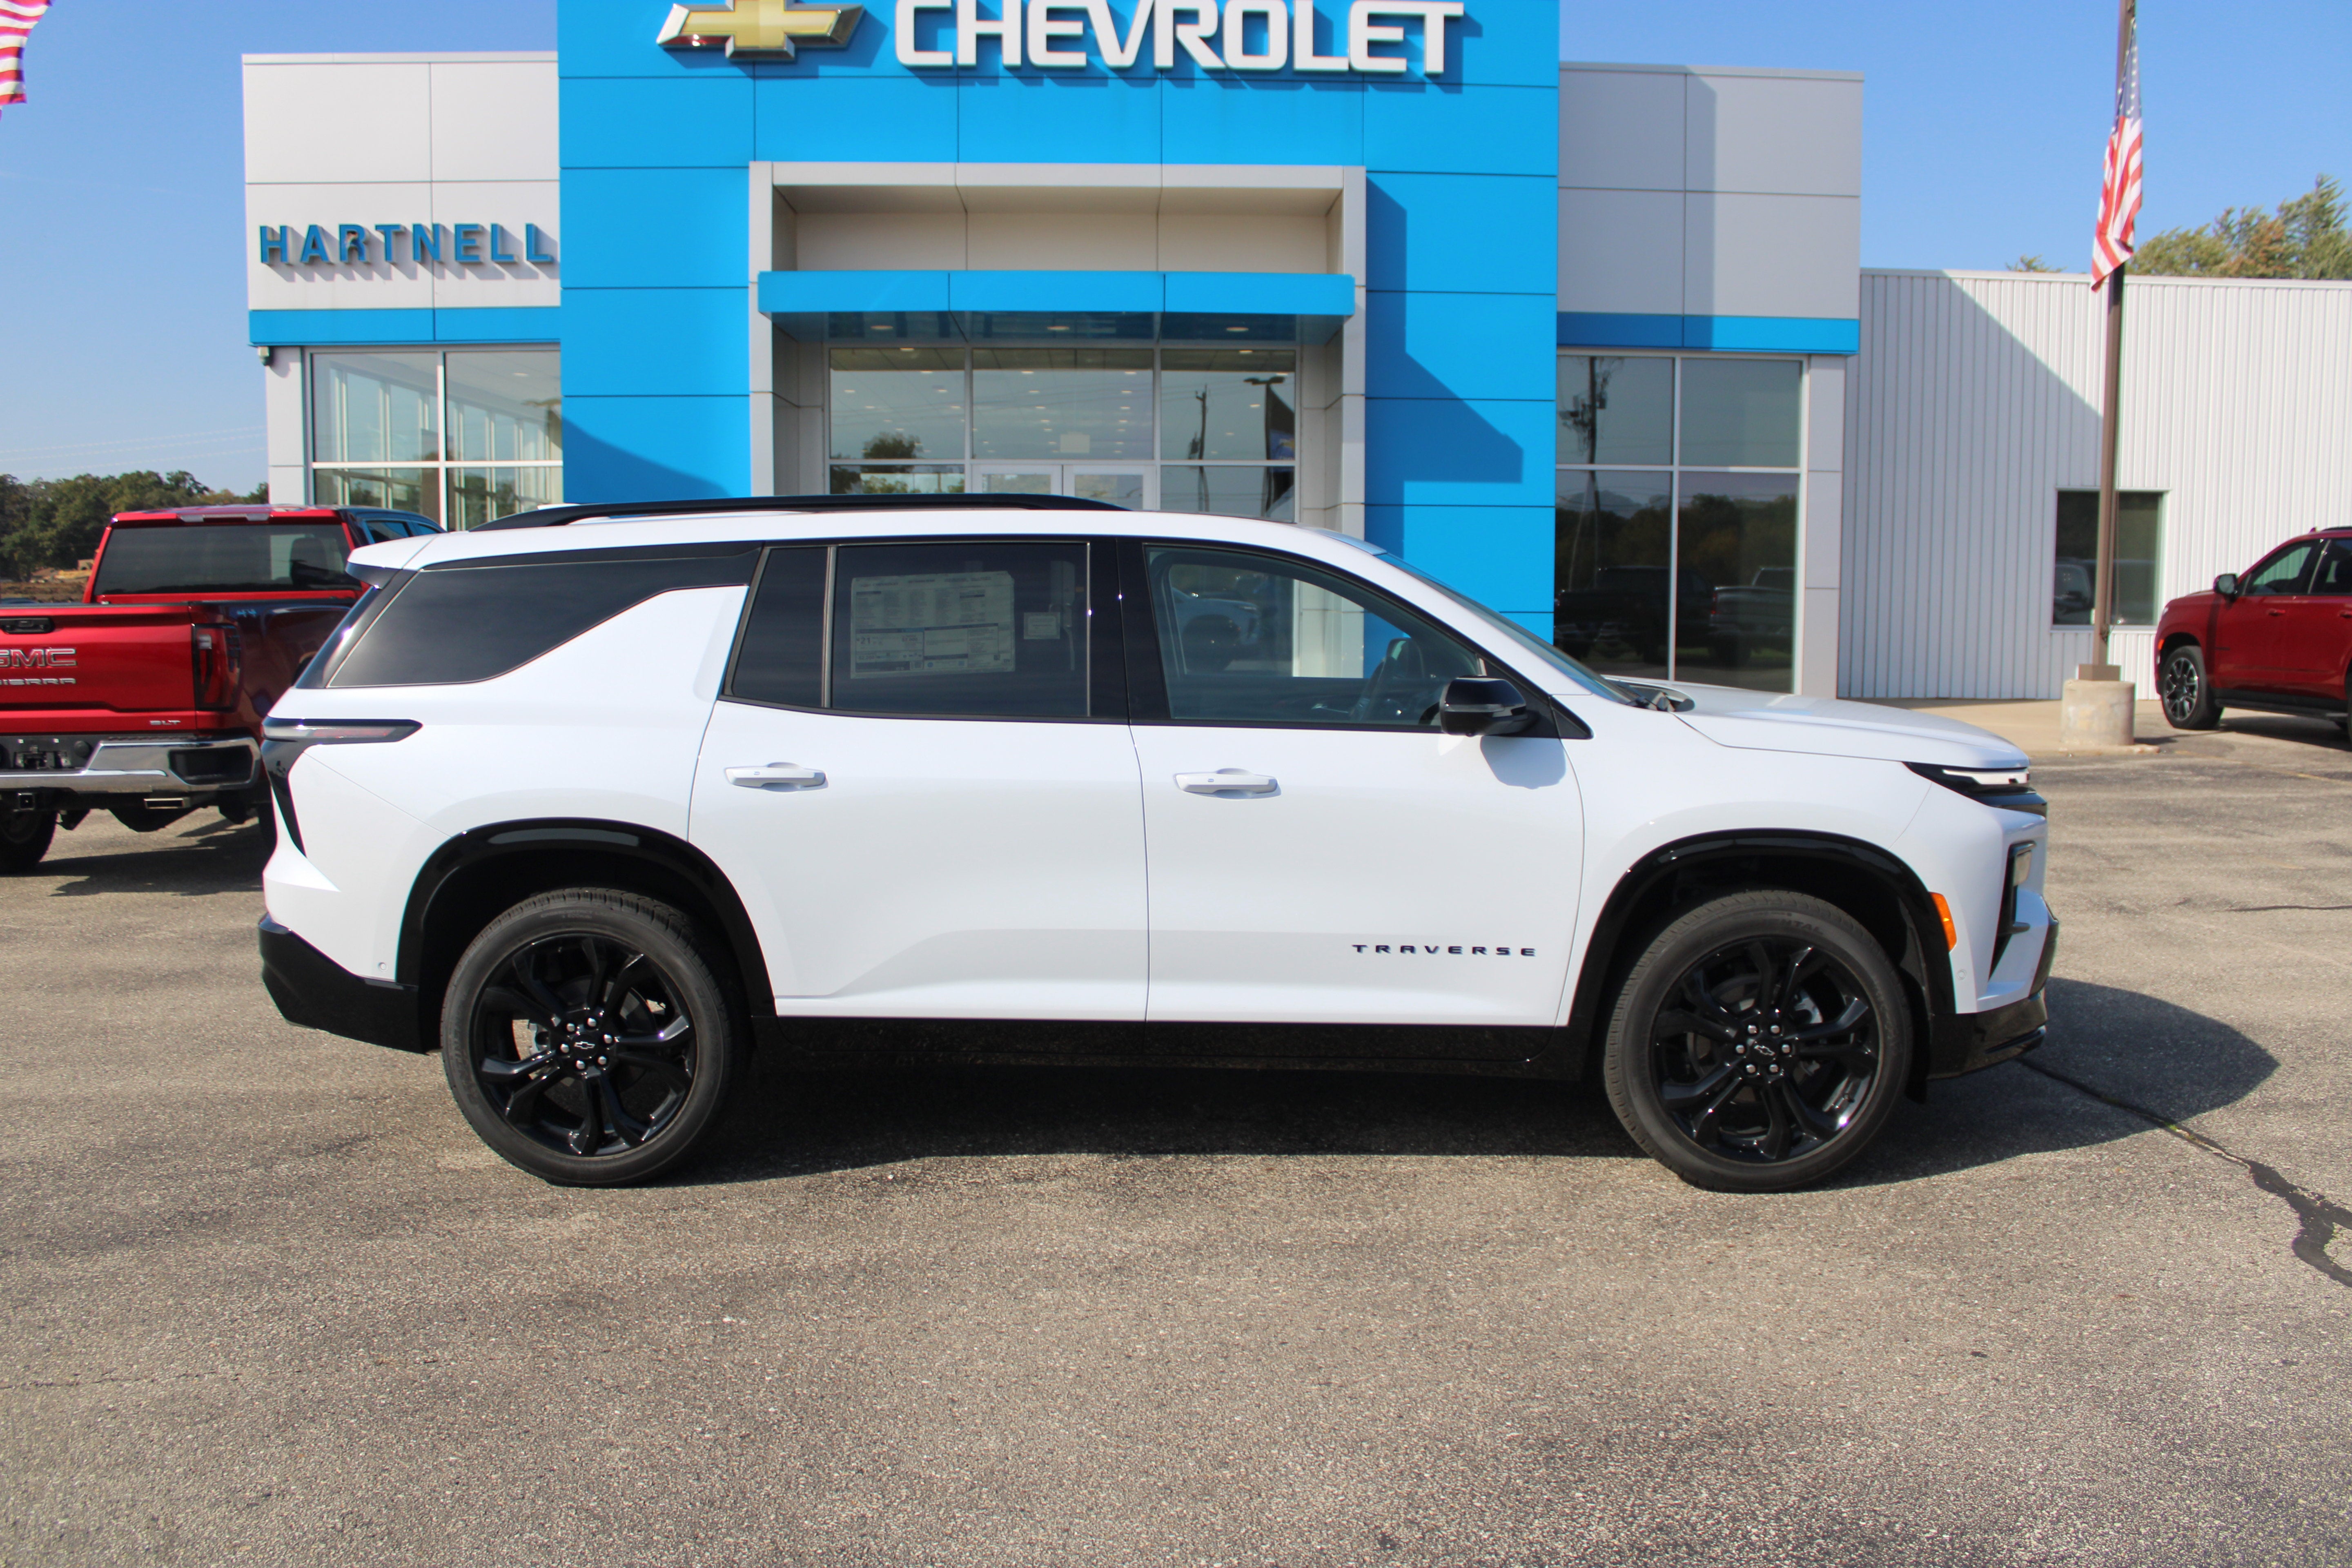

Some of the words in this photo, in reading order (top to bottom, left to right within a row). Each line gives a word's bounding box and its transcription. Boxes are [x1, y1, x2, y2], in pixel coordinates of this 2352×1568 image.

[895, 0, 1465, 74] CHEVROLET
[259, 223, 555, 265] HARTNELL
[1352, 944, 1536, 956] TRAVERSE
